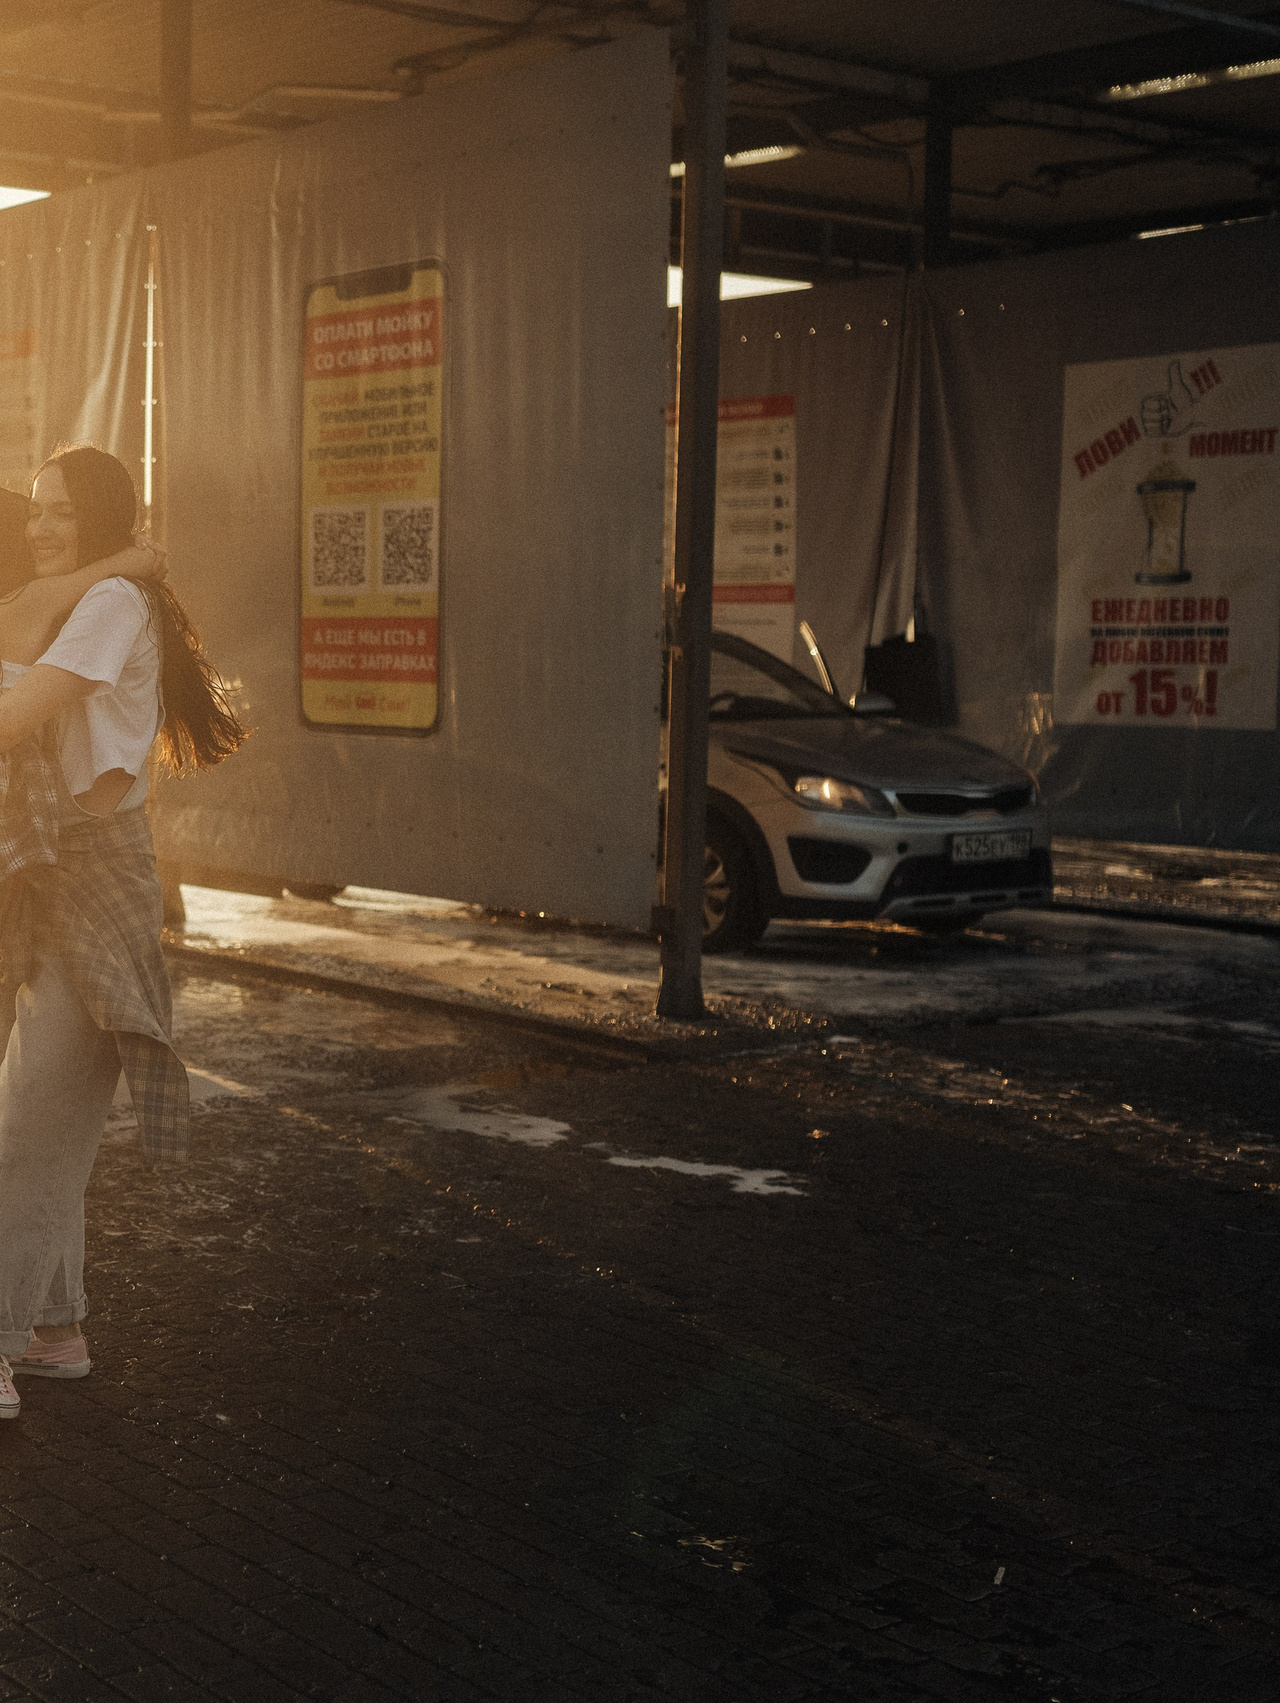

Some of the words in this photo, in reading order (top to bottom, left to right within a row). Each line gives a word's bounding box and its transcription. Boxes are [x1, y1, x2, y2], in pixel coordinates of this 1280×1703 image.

[313, 319, 373, 344] ОПЛАТИ
[376, 310, 434, 336] МОЙКУ
[314, 352, 335, 372] СО
[337, 339, 434, 367] СМАРТФОНА
[1073, 416, 1141, 479] ЛОВИ
[1188, 426, 1279, 458] МОМЕНТ
[1090, 597, 1230, 625] ЕЖЕДНЕВНО
[383, 629, 416, 646] ЕСТЬ
[1090, 639, 1229, 667] ДОБАВЛЯЕМ
